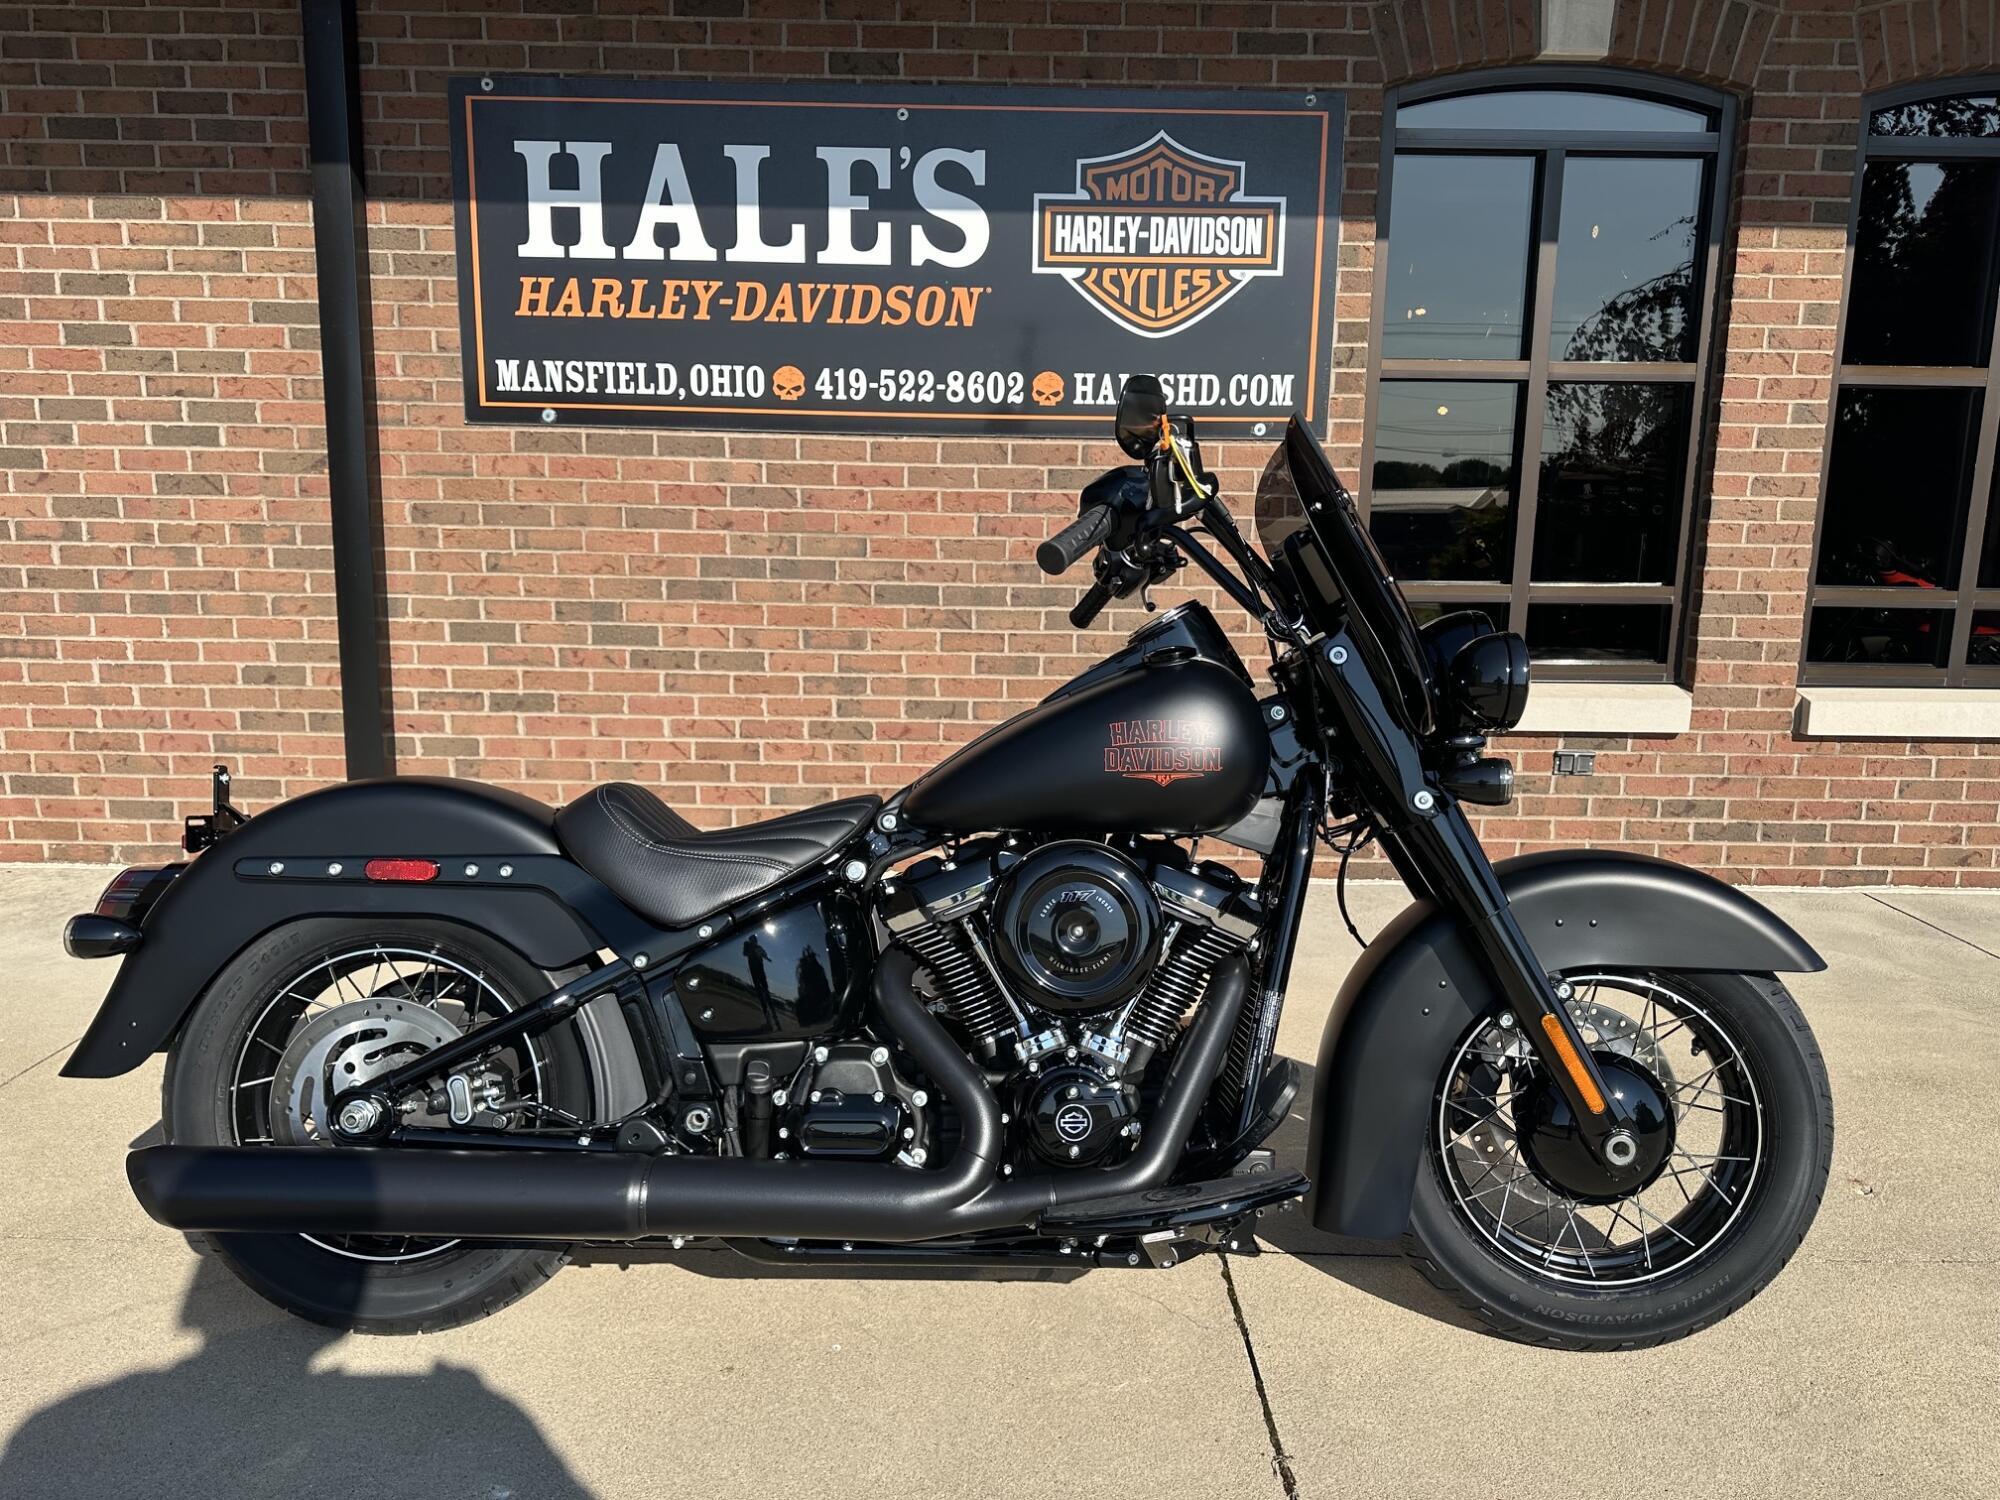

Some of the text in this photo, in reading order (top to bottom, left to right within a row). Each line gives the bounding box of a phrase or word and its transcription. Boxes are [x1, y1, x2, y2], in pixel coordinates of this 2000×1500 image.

[1106, 157, 1216, 202] MOTOR
[514, 140, 991, 269] HALE'S
[1054, 214, 1264, 256] HARLEY-DAVIDSON
[514, 276, 985, 328] HARLEY-DAVIDSON
[1101, 267, 1212, 319] CYCLES
[814, 366, 1025, 405] 419-522-8602
[1072, 372, 1295, 407] HASHD.COM
[1109, 719, 1216, 747] HARLEY
[1104, 747, 1222, 772] DAVIDSON
